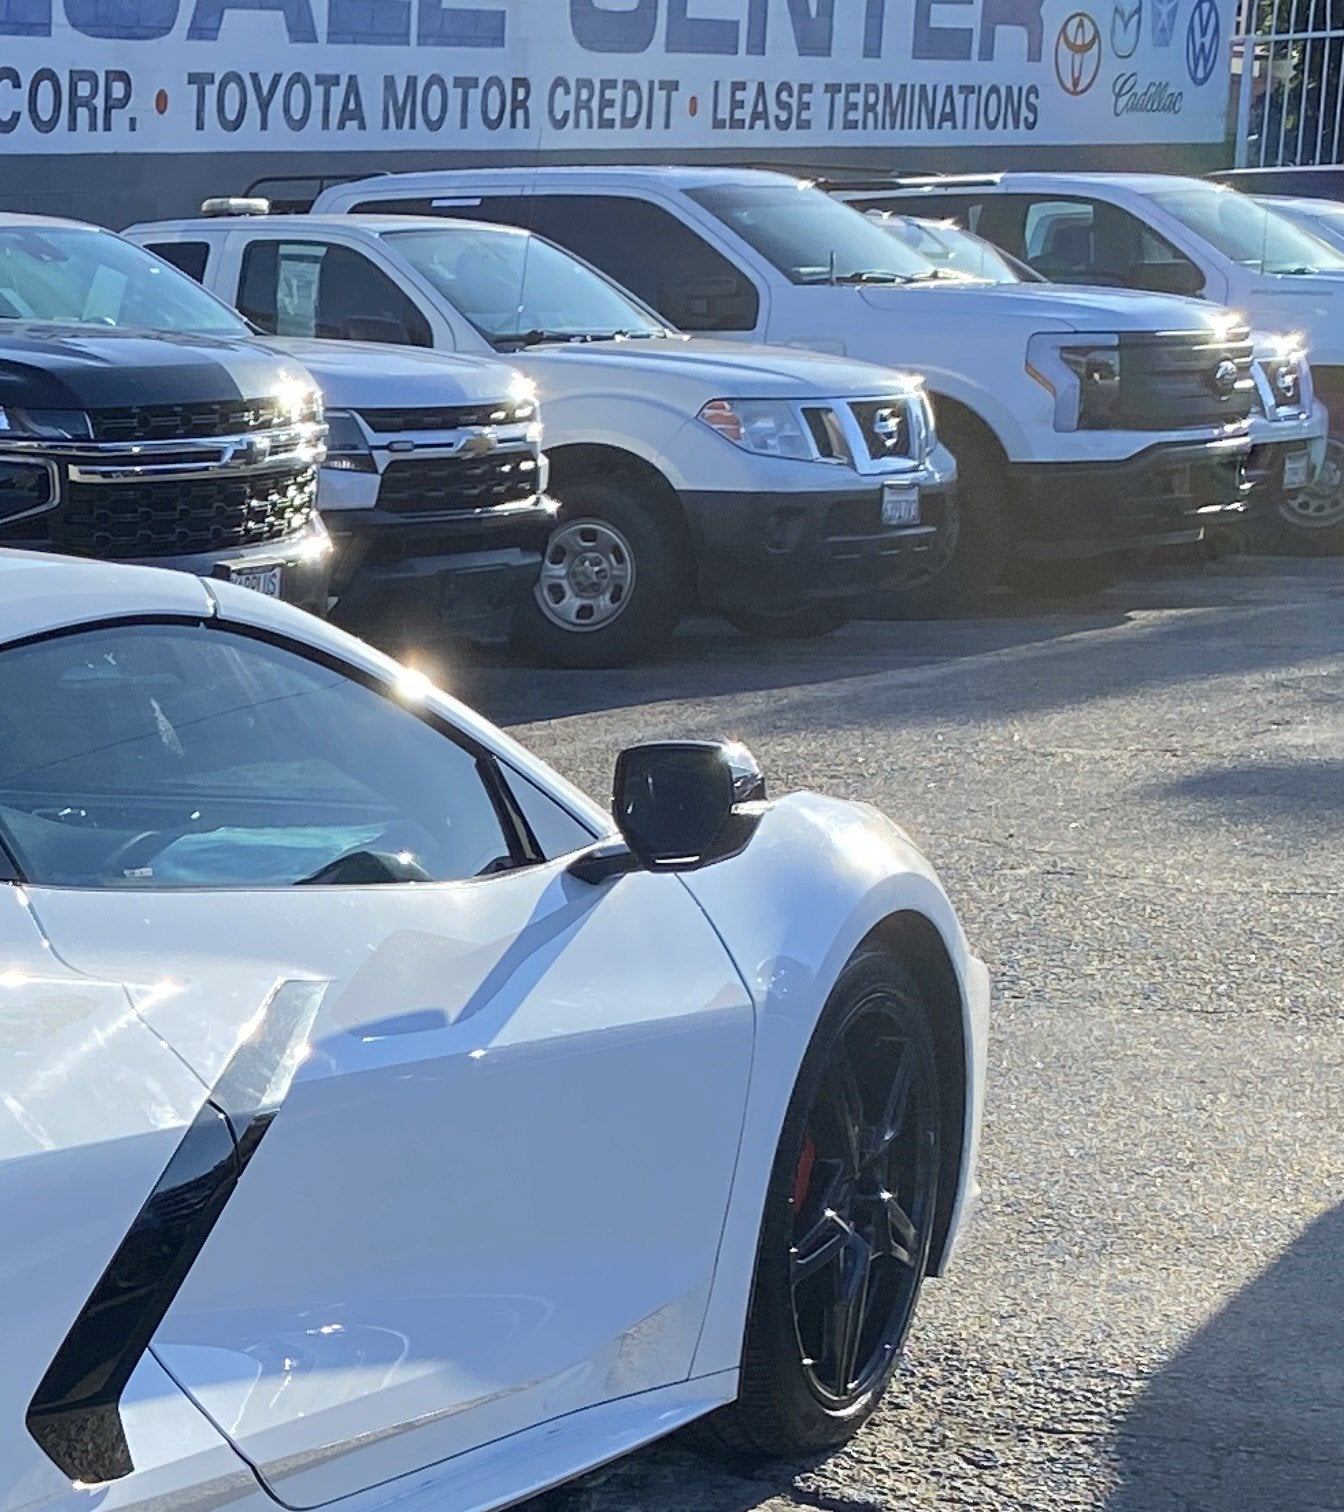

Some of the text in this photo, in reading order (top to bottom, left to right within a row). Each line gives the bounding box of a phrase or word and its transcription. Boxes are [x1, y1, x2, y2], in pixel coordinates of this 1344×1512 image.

[187, 70, 367, 133] TOYOTA
[381, 73, 532, 133] MOTOR
[547, 75, 680, 131] CREDIT
[711, 80, 814, 131] LEASE
[823, 82, 1040, 131] TERMINATIONS
[1112, 72, 1184, 117] Cadillac
